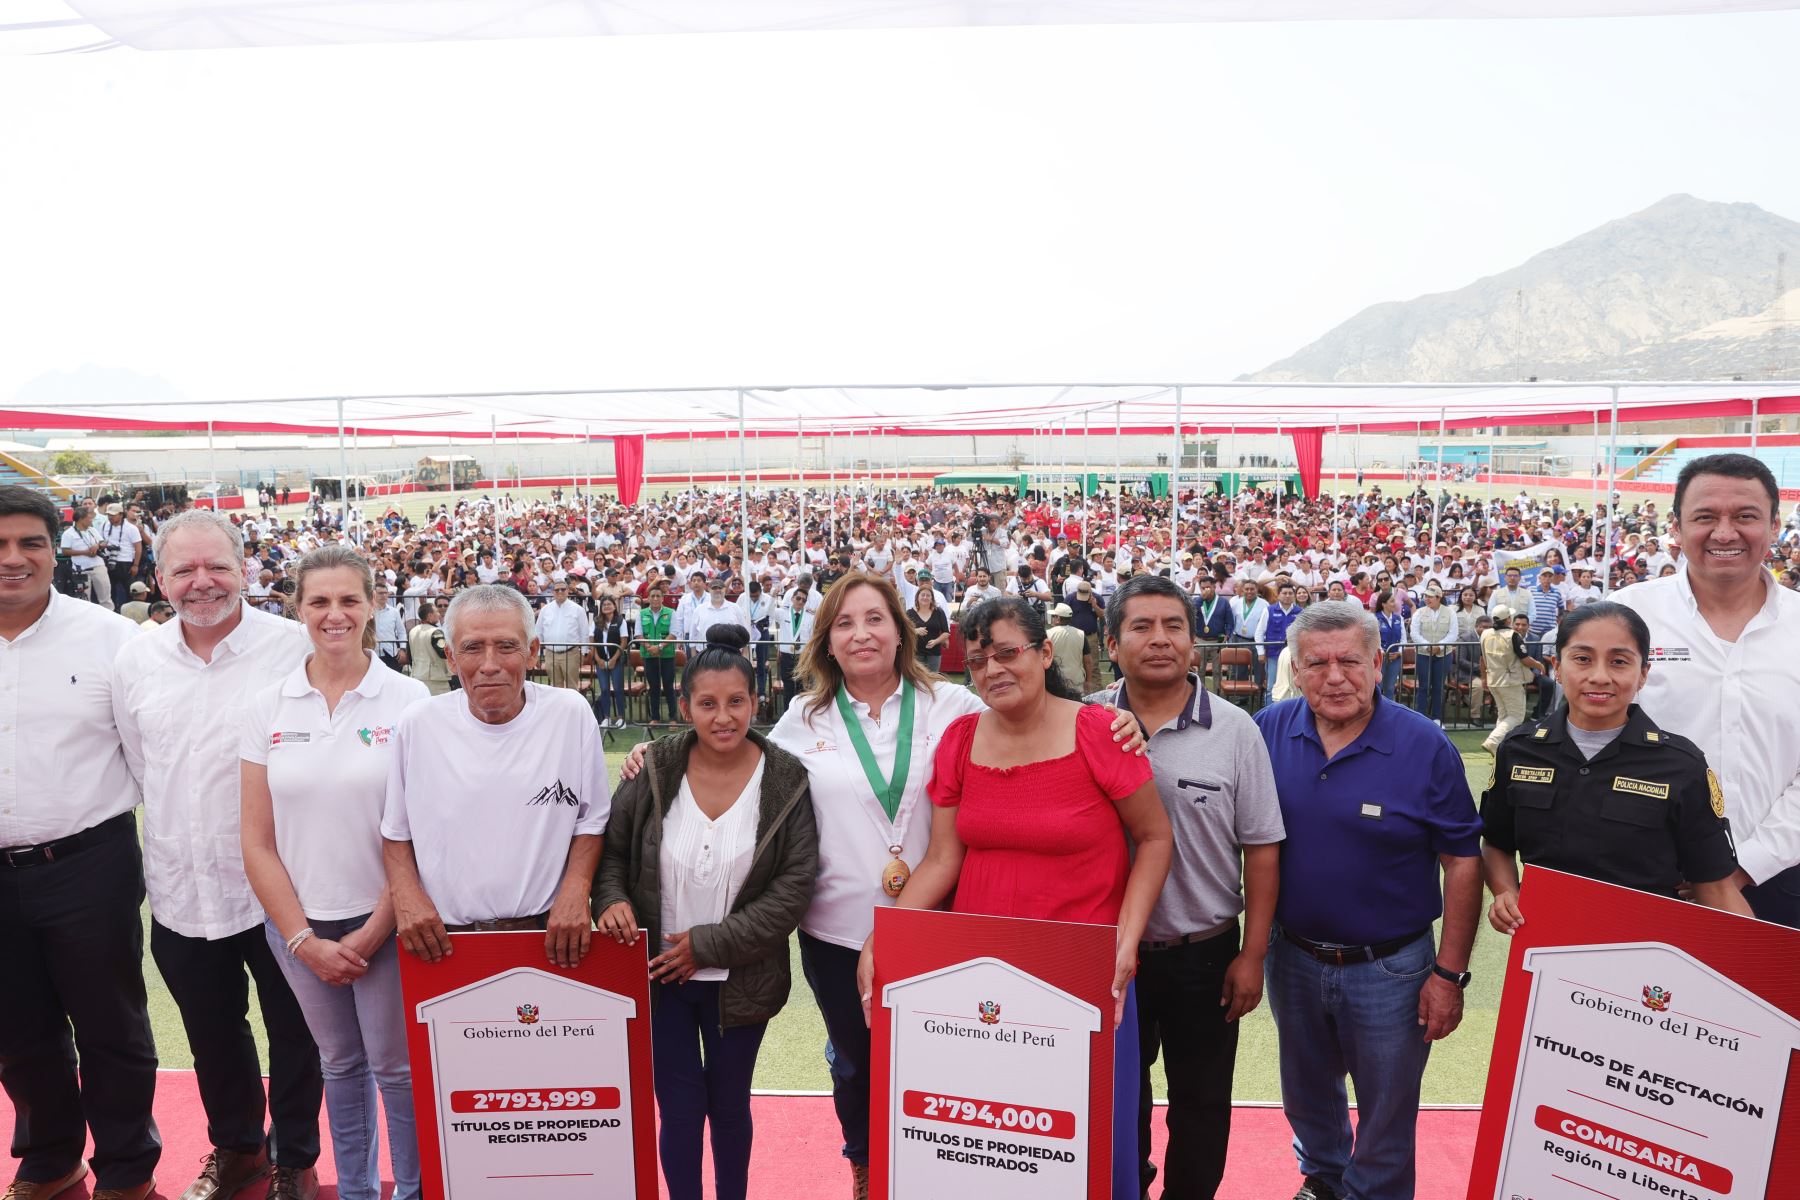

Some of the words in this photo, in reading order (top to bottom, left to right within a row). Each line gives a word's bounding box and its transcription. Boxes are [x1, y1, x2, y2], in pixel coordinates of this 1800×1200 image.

[1616, 780, 1638, 790] POLICIA
[1638, 783, 1666, 796] NACIONAL
[463, 1027, 531, 1039] Gobierno
[536, 1025, 557, 1037] del
[562, 1025, 595, 1037] Perú
[924, 1019, 990, 1040] Gobierno
[995, 1030, 1017, 1043] del
[1022, 1031, 1055, 1047] Perú
[1570, 990, 1653, 1026] Gobierno
[1660, 1017, 1689, 1036] del
[1695, 1026, 1740, 1052] Perú
[1534, 1035, 1605, 1068] TÍTULOS
[1608, 1059, 1635, 1077] DE
[1638, 1069, 1764, 1119] AFECTACIÓN
[1605, 1075, 1632, 1093] EN
[1634, 1085, 1675, 1107] USO
[451, 1120, 511, 1132] TÍTULOS
[514, 1120, 533, 1131] DE
[537, 1118, 621, 1130] PROPIEDAD
[488, 1132, 587, 1144] REGISTRADOS
[902, 1126, 960, 1147] TÍTULOS
[963, 1136, 984, 1150] DE
[987, 1140, 1076, 1163] PROPIEDAD
[1560, 1118, 1702, 1181] COMISARÍA
[936, 1148, 1039, 1174] REGISTRADOS
[1543, 1140, 1602, 1171] Región
[1607, 1162, 1628, 1179] La
[1632, 1171, 1711, 1200] Liberta
